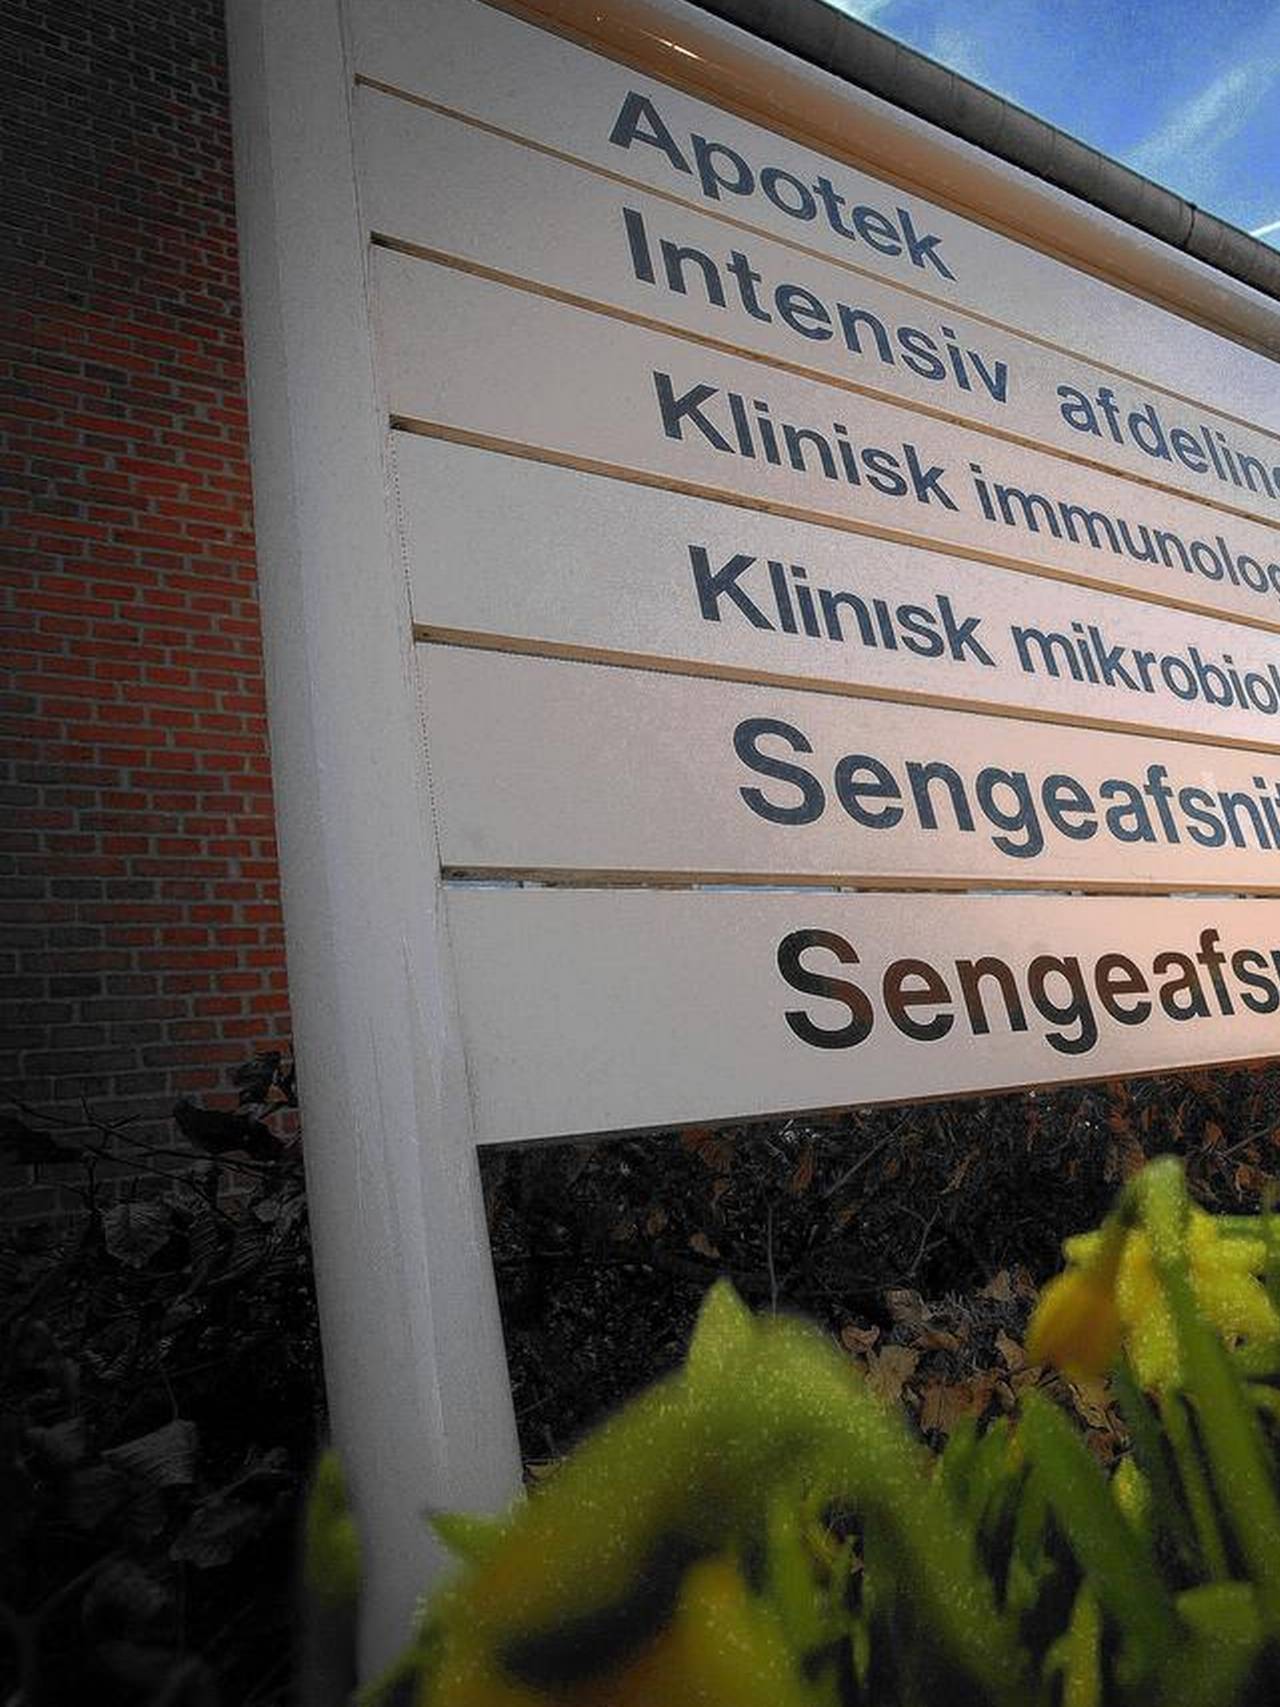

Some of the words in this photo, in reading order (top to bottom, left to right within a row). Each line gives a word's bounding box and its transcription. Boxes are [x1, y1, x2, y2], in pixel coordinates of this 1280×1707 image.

[609, 90, 957, 281] Apotek
[624, 206, 1008, 404] Intensiv
[652, 371, 959, 511] Klinisk
[688, 544, 997, 667] Klinisk
